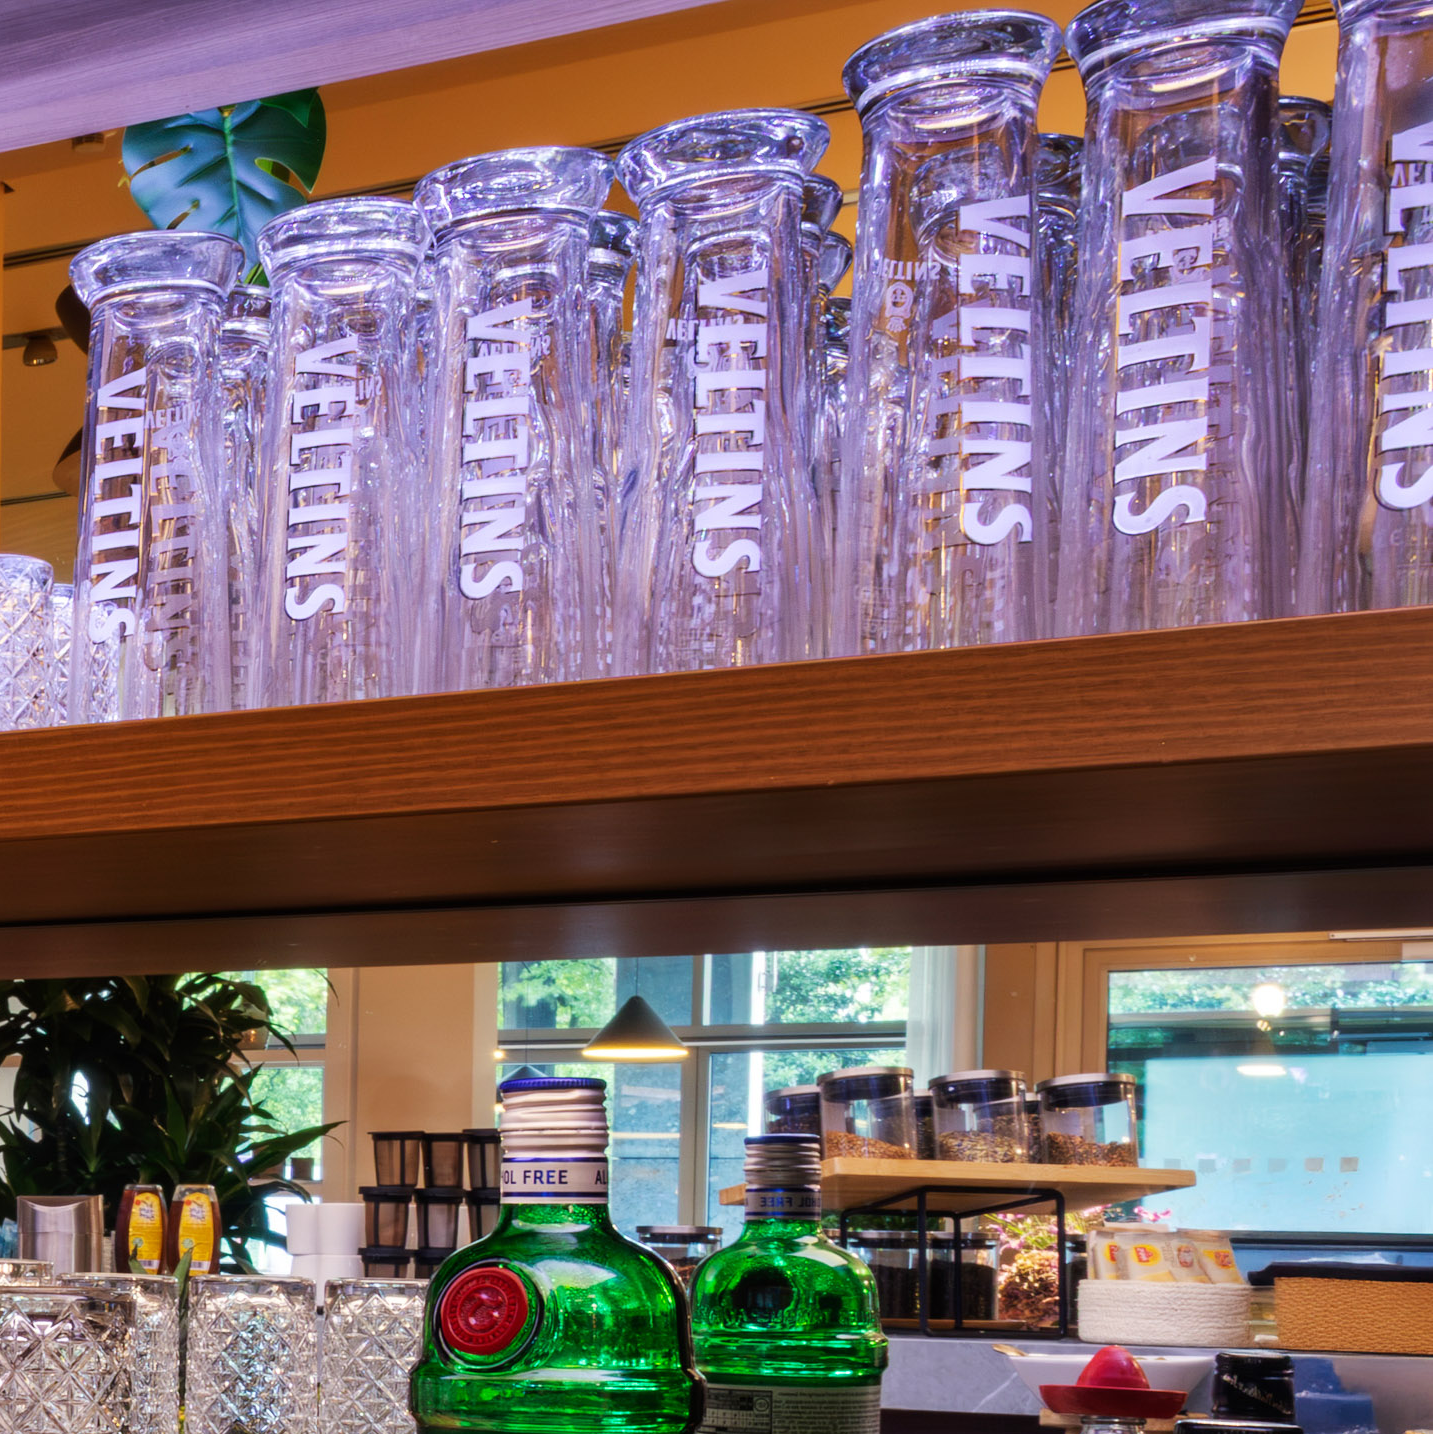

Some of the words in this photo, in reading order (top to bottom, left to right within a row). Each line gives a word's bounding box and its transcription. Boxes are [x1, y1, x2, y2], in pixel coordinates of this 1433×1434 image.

[284, 333, 360, 622] VELTINS
[460, 298, 532, 600] VELTINS
[692, 269, 769, 578] VELTINS
[959, 195, 1032, 545] VELTINS
[1113, 157, 1217, 535] VELTINS
[88, 367, 147, 644] VELTINS
[523, 1170, 569, 1185] FREE
